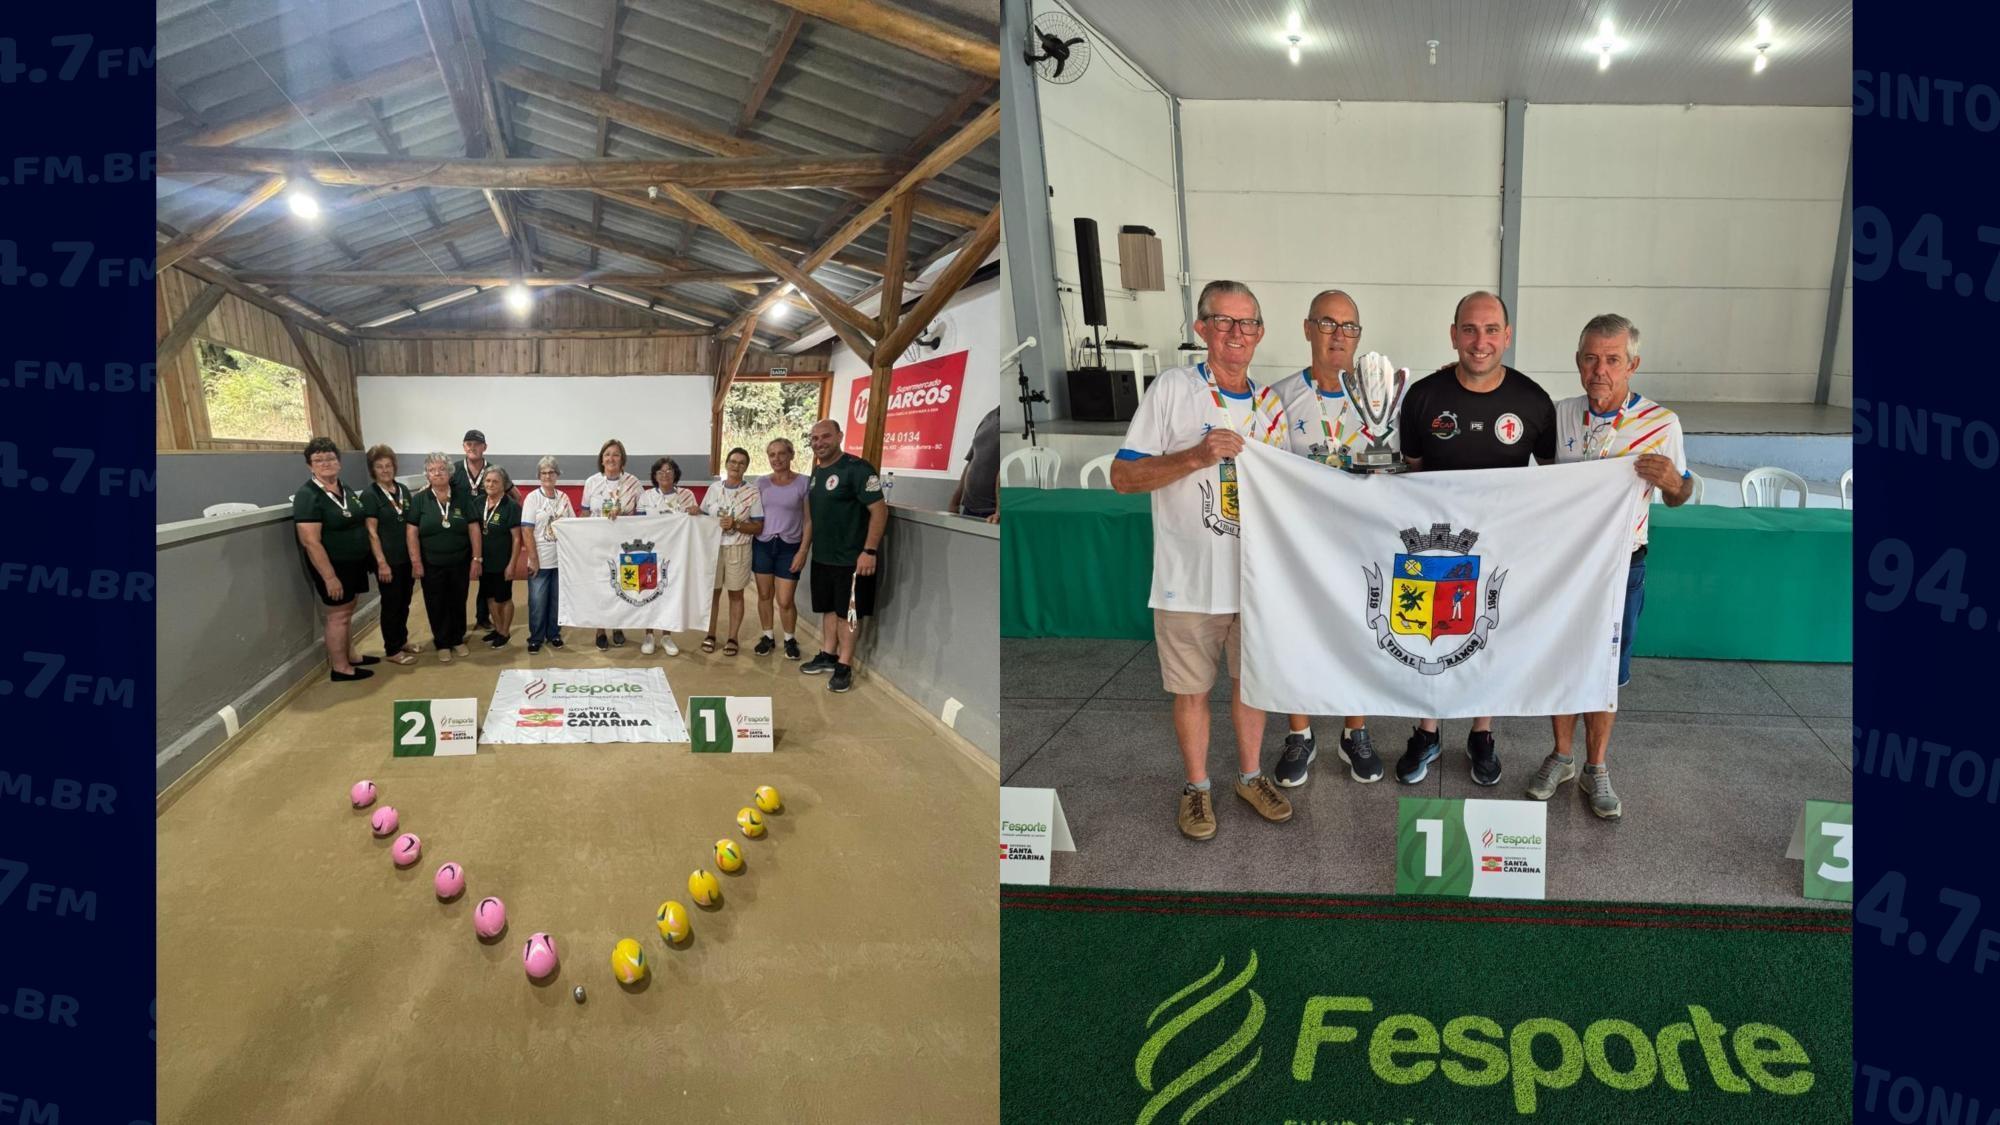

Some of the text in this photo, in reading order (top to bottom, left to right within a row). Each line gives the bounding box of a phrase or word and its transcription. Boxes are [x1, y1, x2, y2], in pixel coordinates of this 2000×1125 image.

[897, 431, 920, 442] 0134
[1369, 586, 1380, 609] 1919
[1386, 638, 1479, 666] VIDAL RAMOS
[552, 682, 643, 696] Fesporte
[567, 711, 621, 719] SANTA
[567, 719, 653, 727] CATARINA
[699, 709, 716, 742] 1
[400, 711, 426, 745] 2
[1002, 821, 1047, 833] Fesporte
[1416, 819, 1443, 877] 1
[1495, 833, 1542, 846] Fesporte
[1817, 822, 1853, 882] 3
[1291, 995, 1816, 1113] Fesporte
